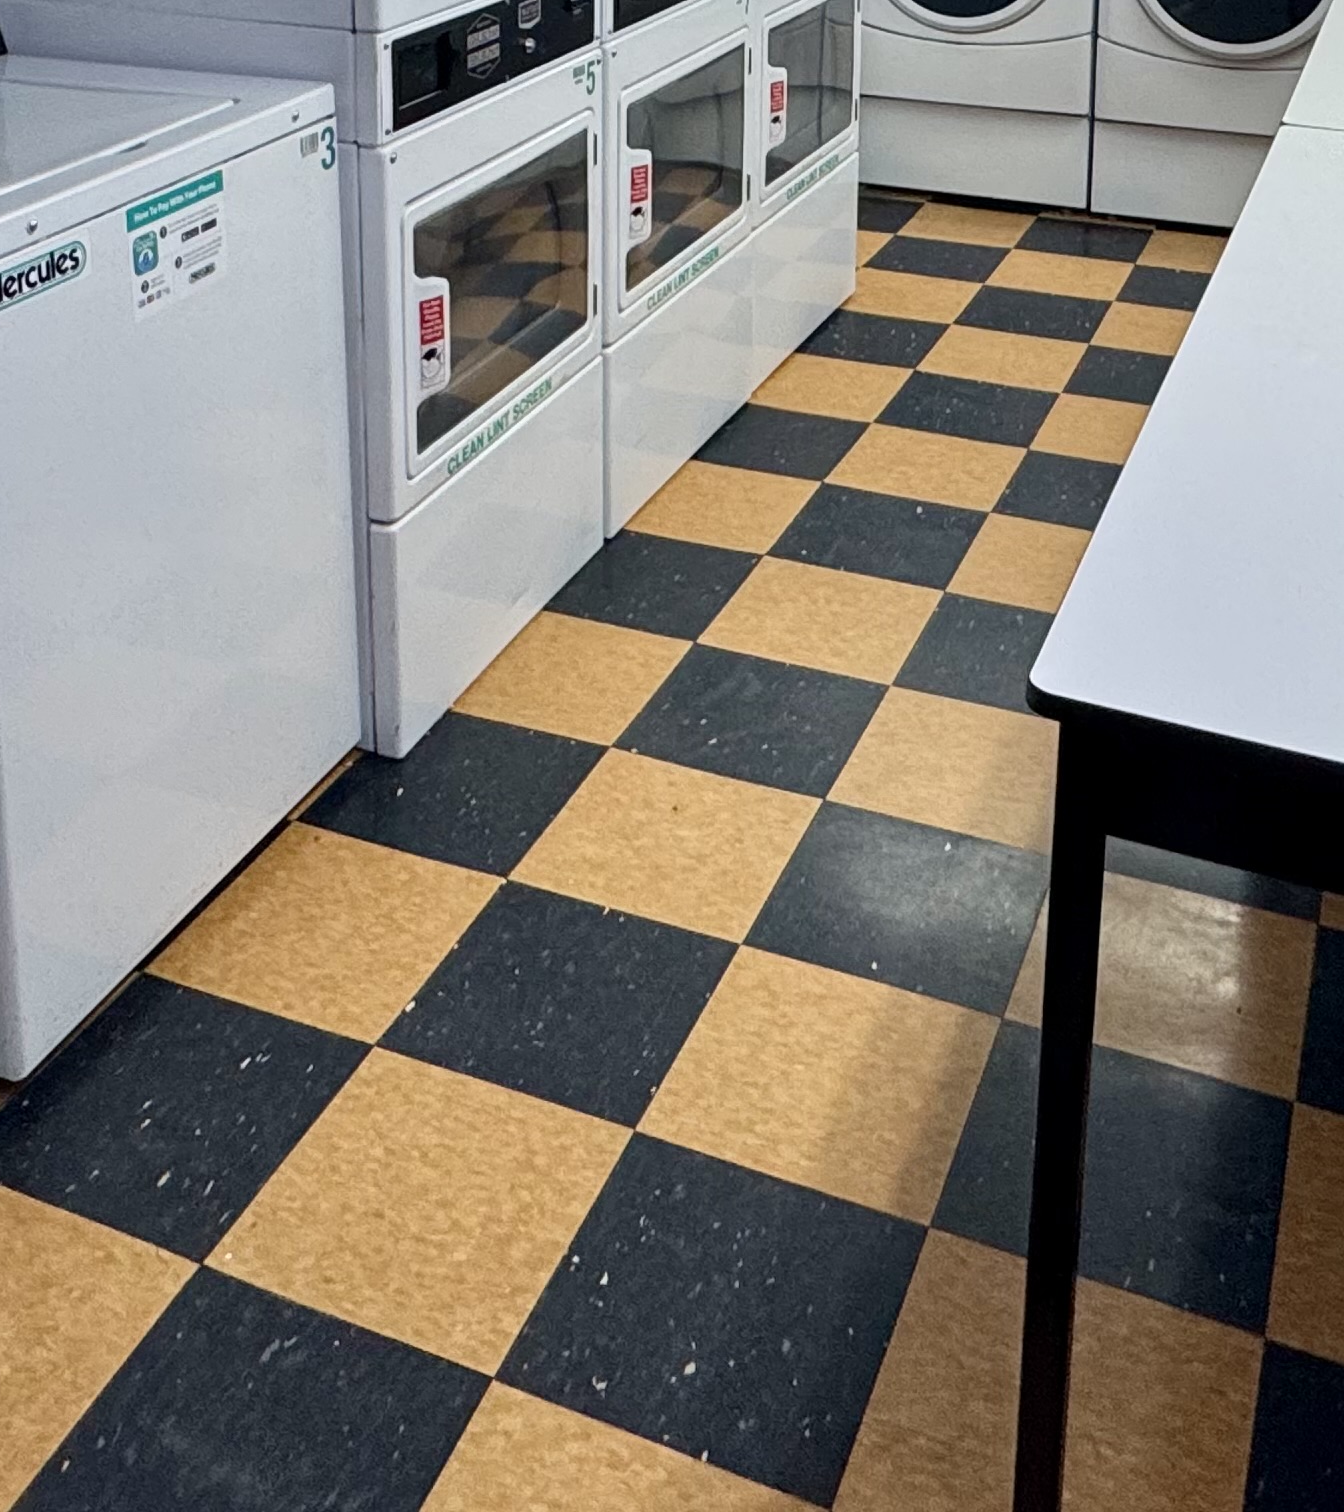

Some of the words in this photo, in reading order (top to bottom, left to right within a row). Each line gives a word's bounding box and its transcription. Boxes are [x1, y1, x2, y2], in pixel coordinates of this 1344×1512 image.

[586, 60, 595, 95] 5
[320, 126, 335, 170] 3
[447, 432, 484, 475] CLEAN
[487, 410, 510, 441] LINT
[512, 376, 553, 420] SCREEN
